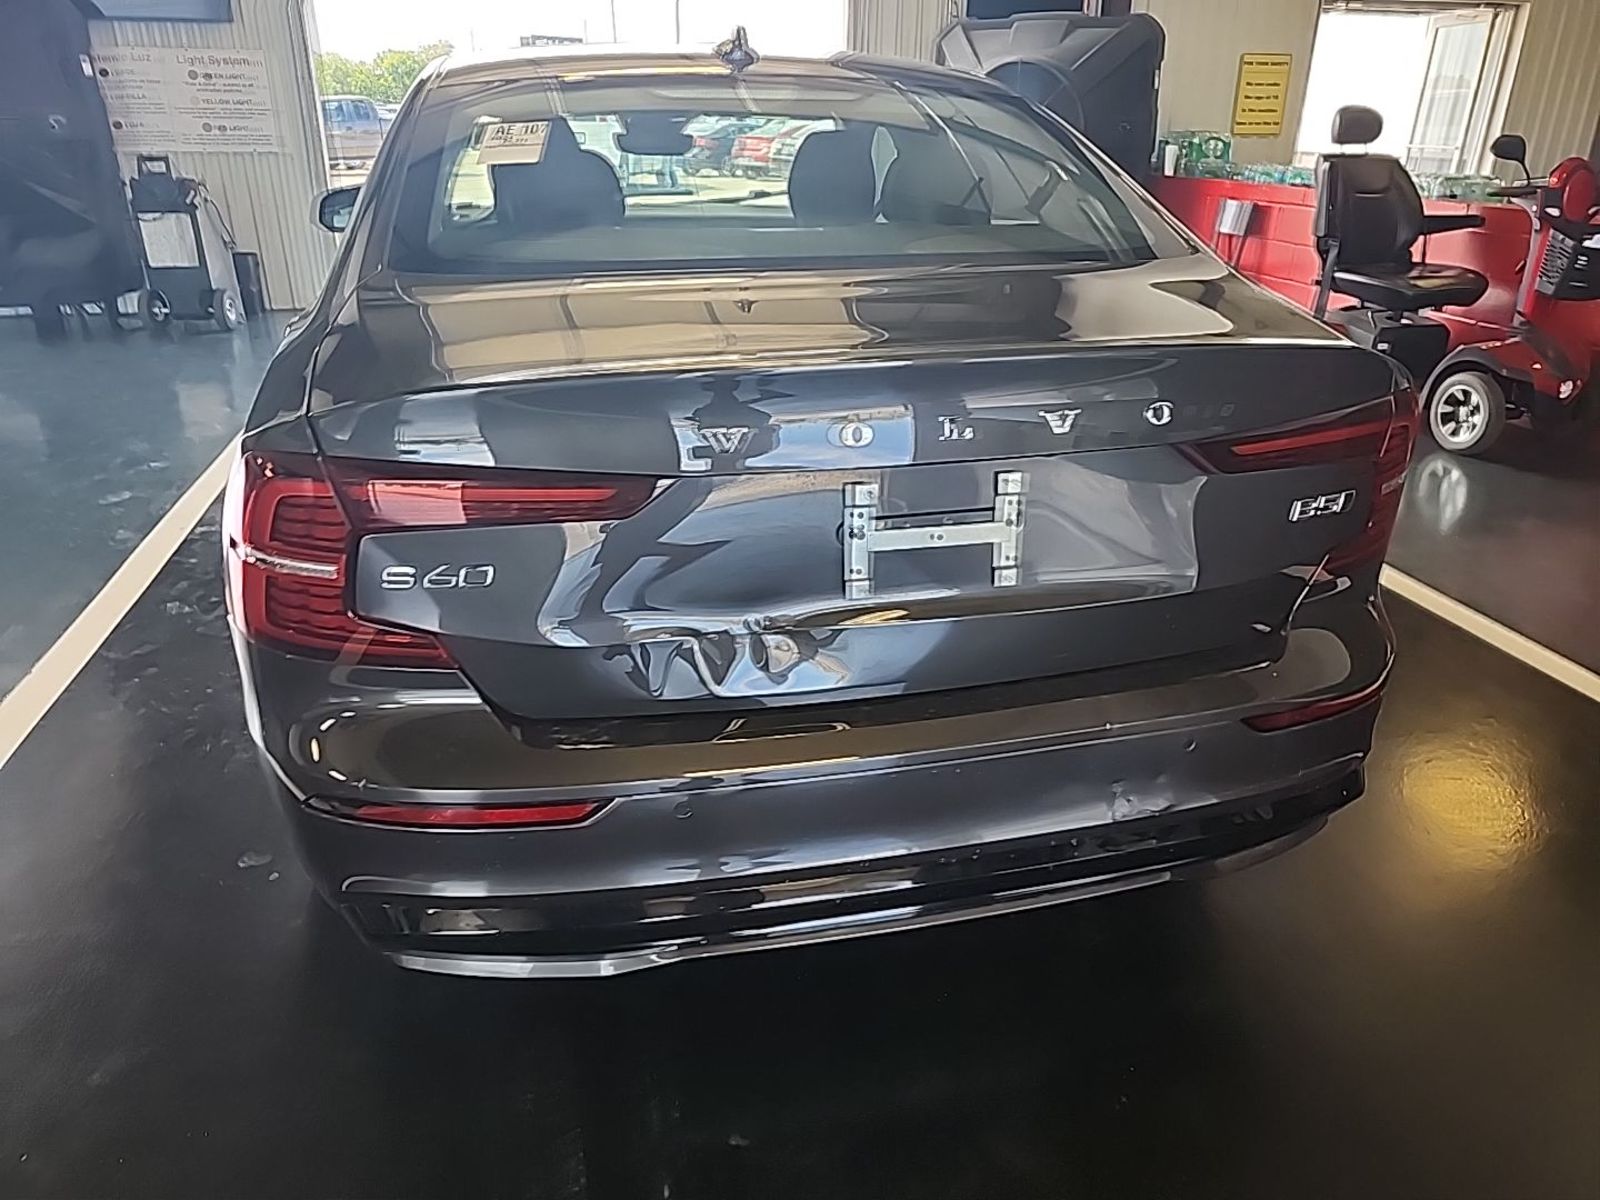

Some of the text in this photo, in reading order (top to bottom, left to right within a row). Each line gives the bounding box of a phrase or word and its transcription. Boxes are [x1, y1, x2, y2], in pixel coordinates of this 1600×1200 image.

[176, 55, 250, 68] Light System
[380, 563, 496, 590] S60
